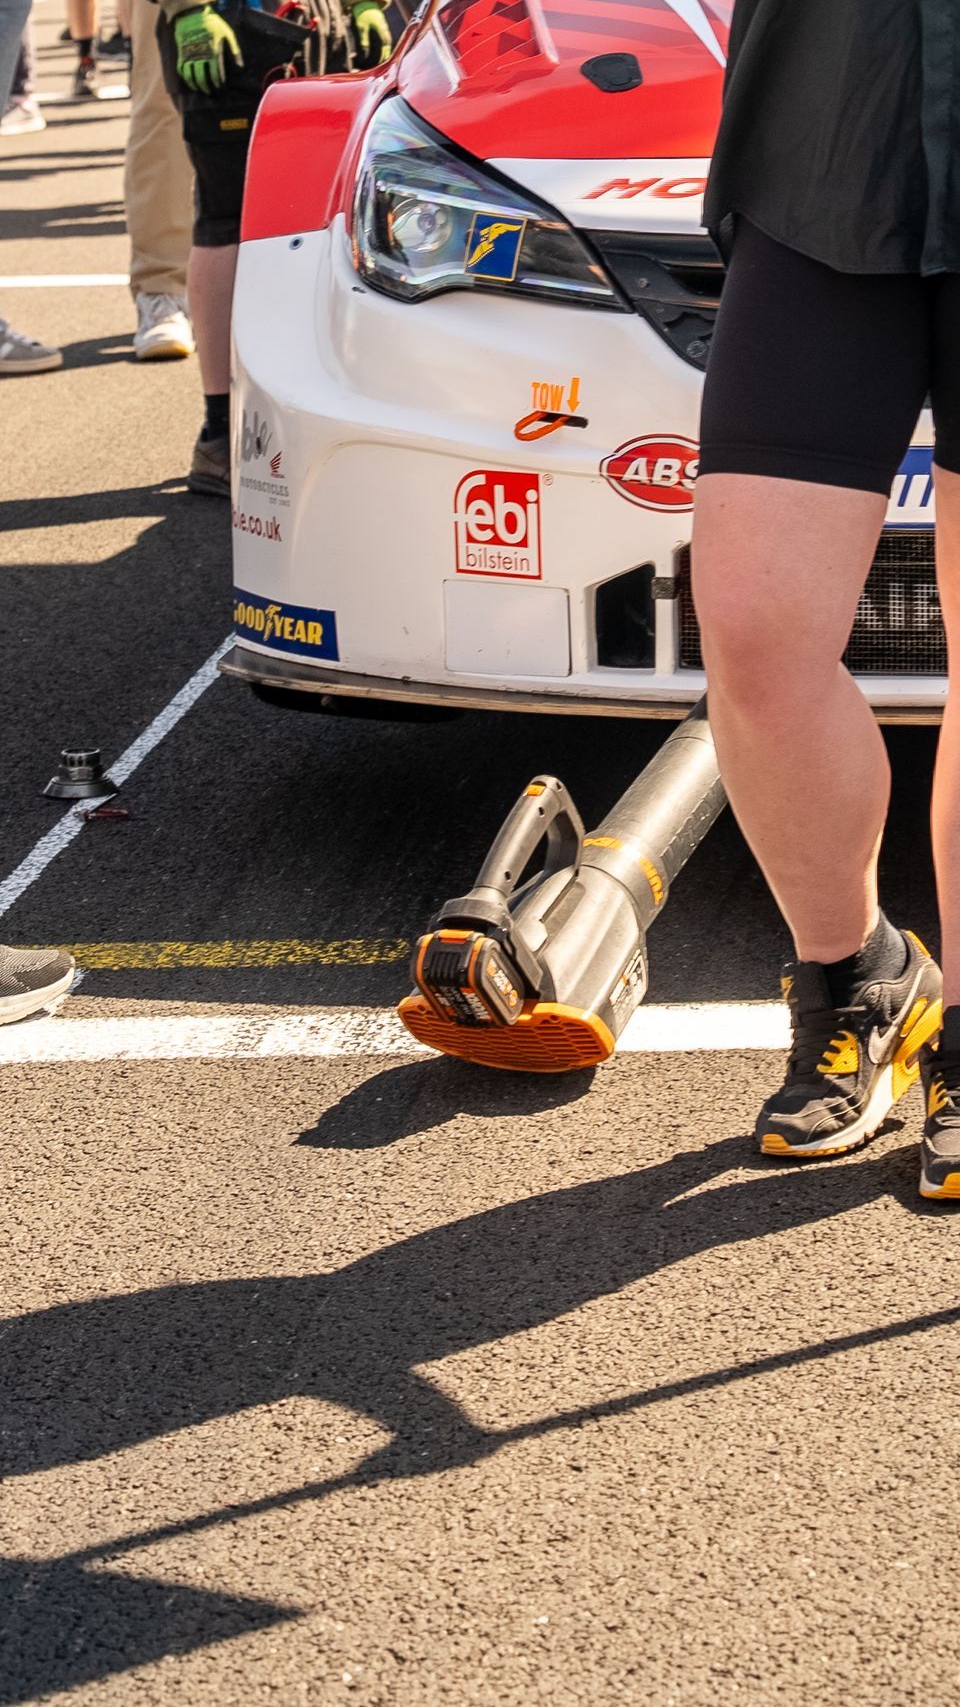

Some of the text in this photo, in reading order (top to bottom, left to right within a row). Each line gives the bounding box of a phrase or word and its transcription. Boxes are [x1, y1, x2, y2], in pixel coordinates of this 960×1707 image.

[531, 382, 564, 411] TOW
[453, 474, 539, 547] febi
[465, 545, 530, 573] bilstein
[233, 600, 323, 645] OODYEAR
